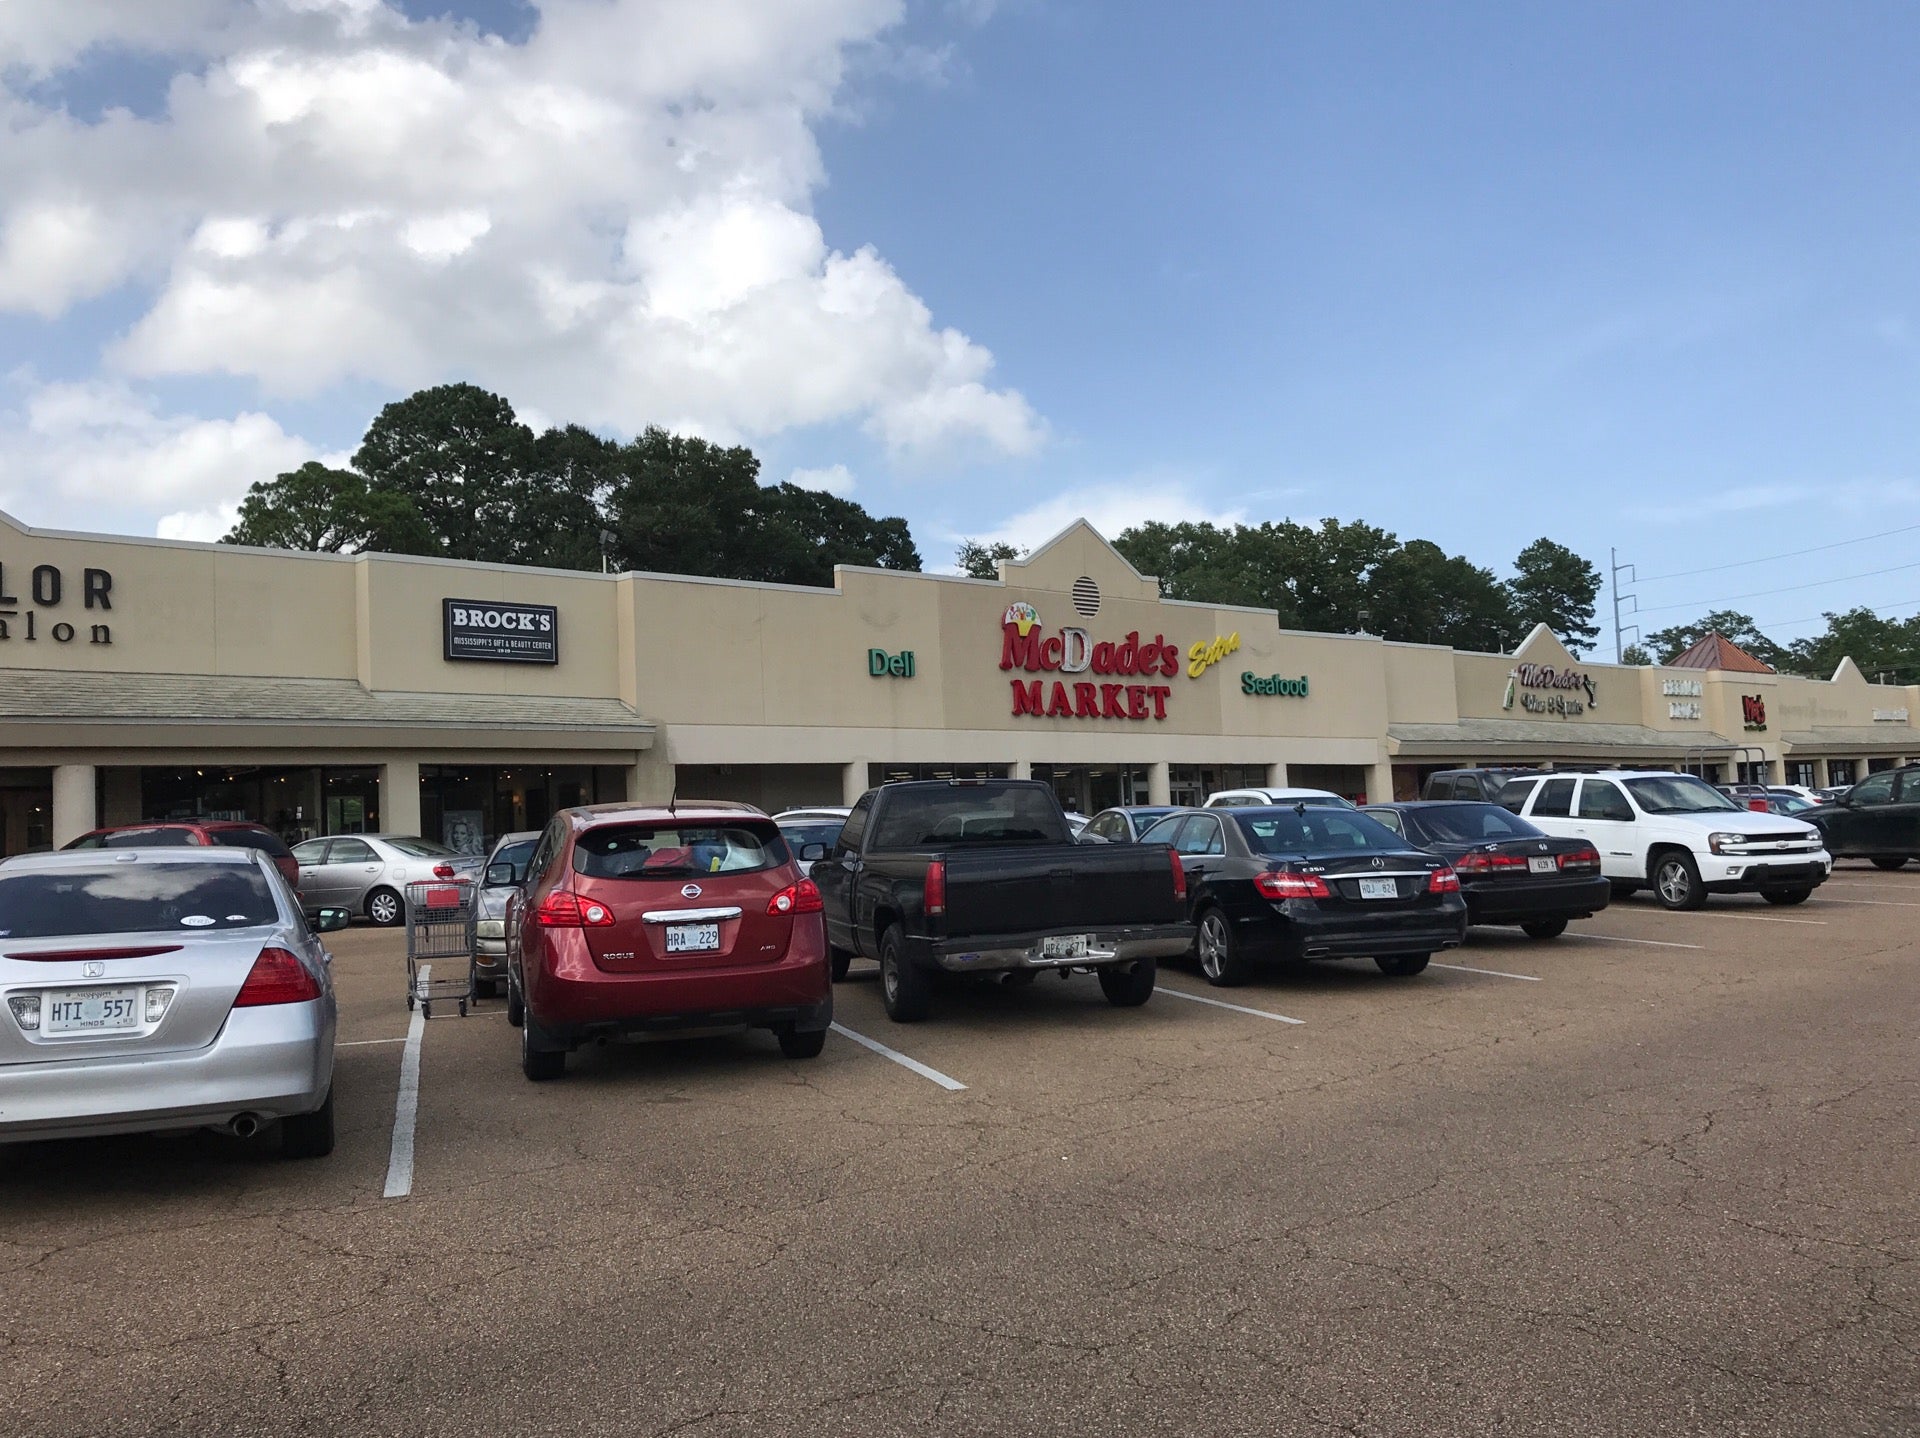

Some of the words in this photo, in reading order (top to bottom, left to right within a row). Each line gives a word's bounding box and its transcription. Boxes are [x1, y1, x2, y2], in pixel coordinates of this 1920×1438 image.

[453, 608, 551, 632] BROCK'S
[493, 639, 505, 647] GIFT
[510, 640, 531, 649] BEAUTY
[532, 641, 552, 650] CENTER
[999, 618, 1179, 677] McDade's
[1187, 631, 1242, 679] Extra
[868, 648, 916, 678] Deli
[1241, 671, 1309, 697] Seafood
[1010, 679, 1171, 720] MARKET
[667, 932, 686, 946] HRA
[699, 930, 718, 944] 229
[602, 952, 635, 960] ROGUE
[52, 1002, 83, 1021] HTI
[103, 999, 134, 1019] 557
